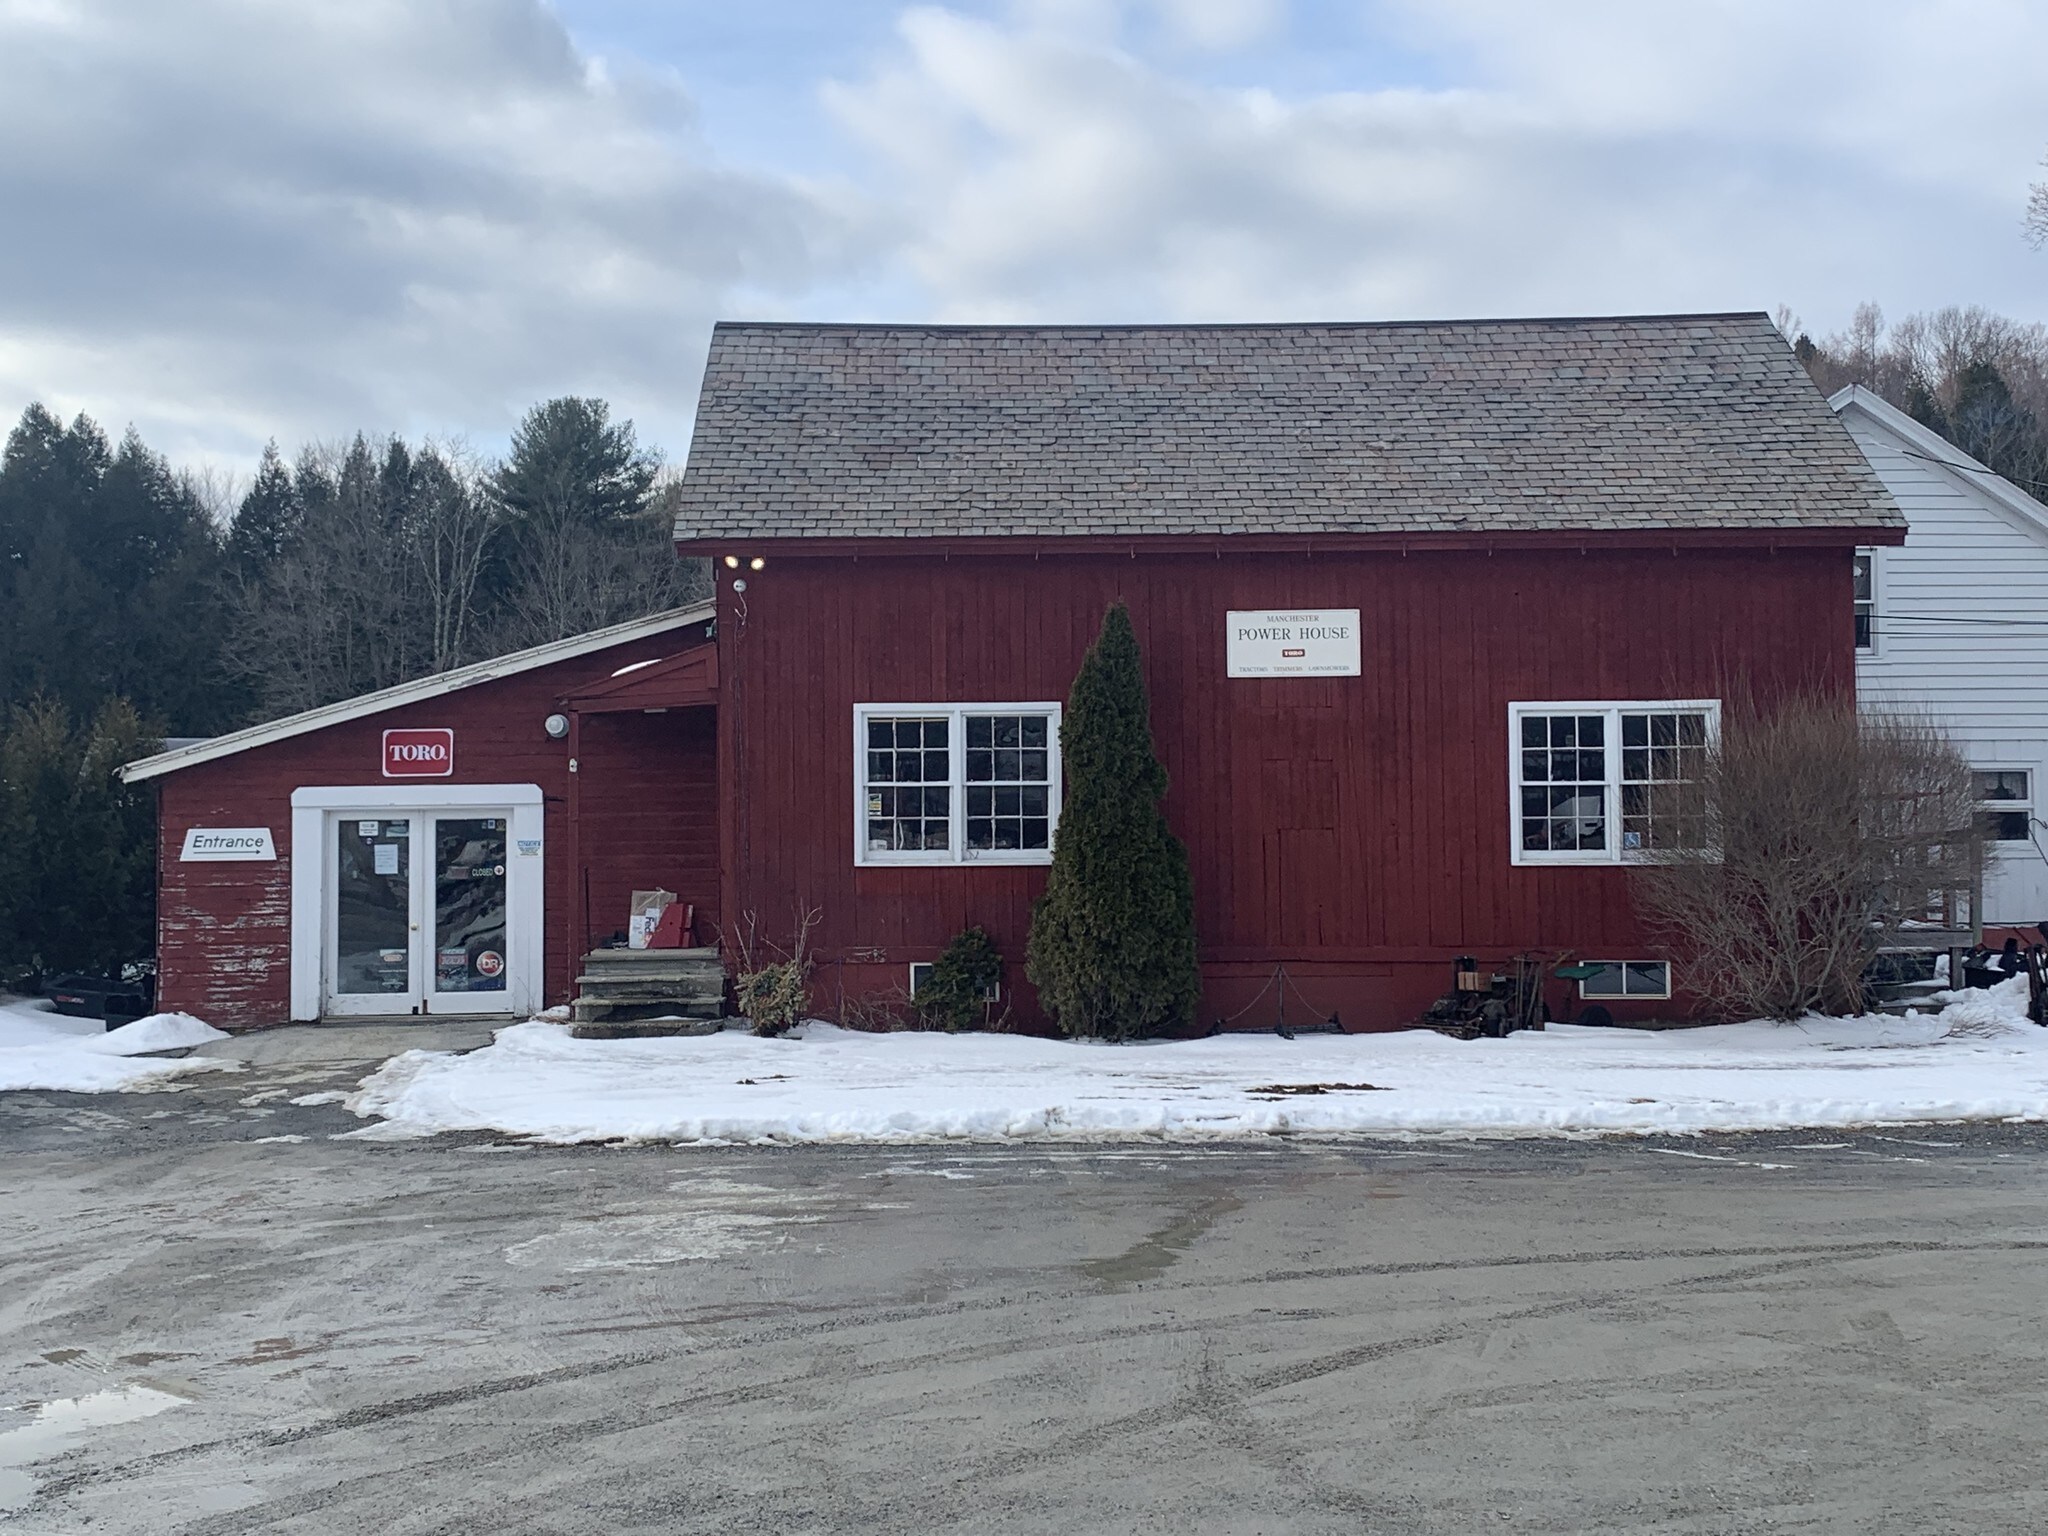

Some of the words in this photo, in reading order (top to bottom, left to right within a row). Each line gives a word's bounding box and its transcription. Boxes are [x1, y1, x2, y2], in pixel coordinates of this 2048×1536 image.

[1267, 615, 1320, 623] MANCHESTER
[1238, 628, 1291, 641] POWER
[1300, 627, 1350, 640] HOUSE
[389, 744, 446, 761] TORO
[193, 835, 264, 848] Entrance
[472, 868, 493, 876] CLOSED
[482, 958, 499, 969] DR
